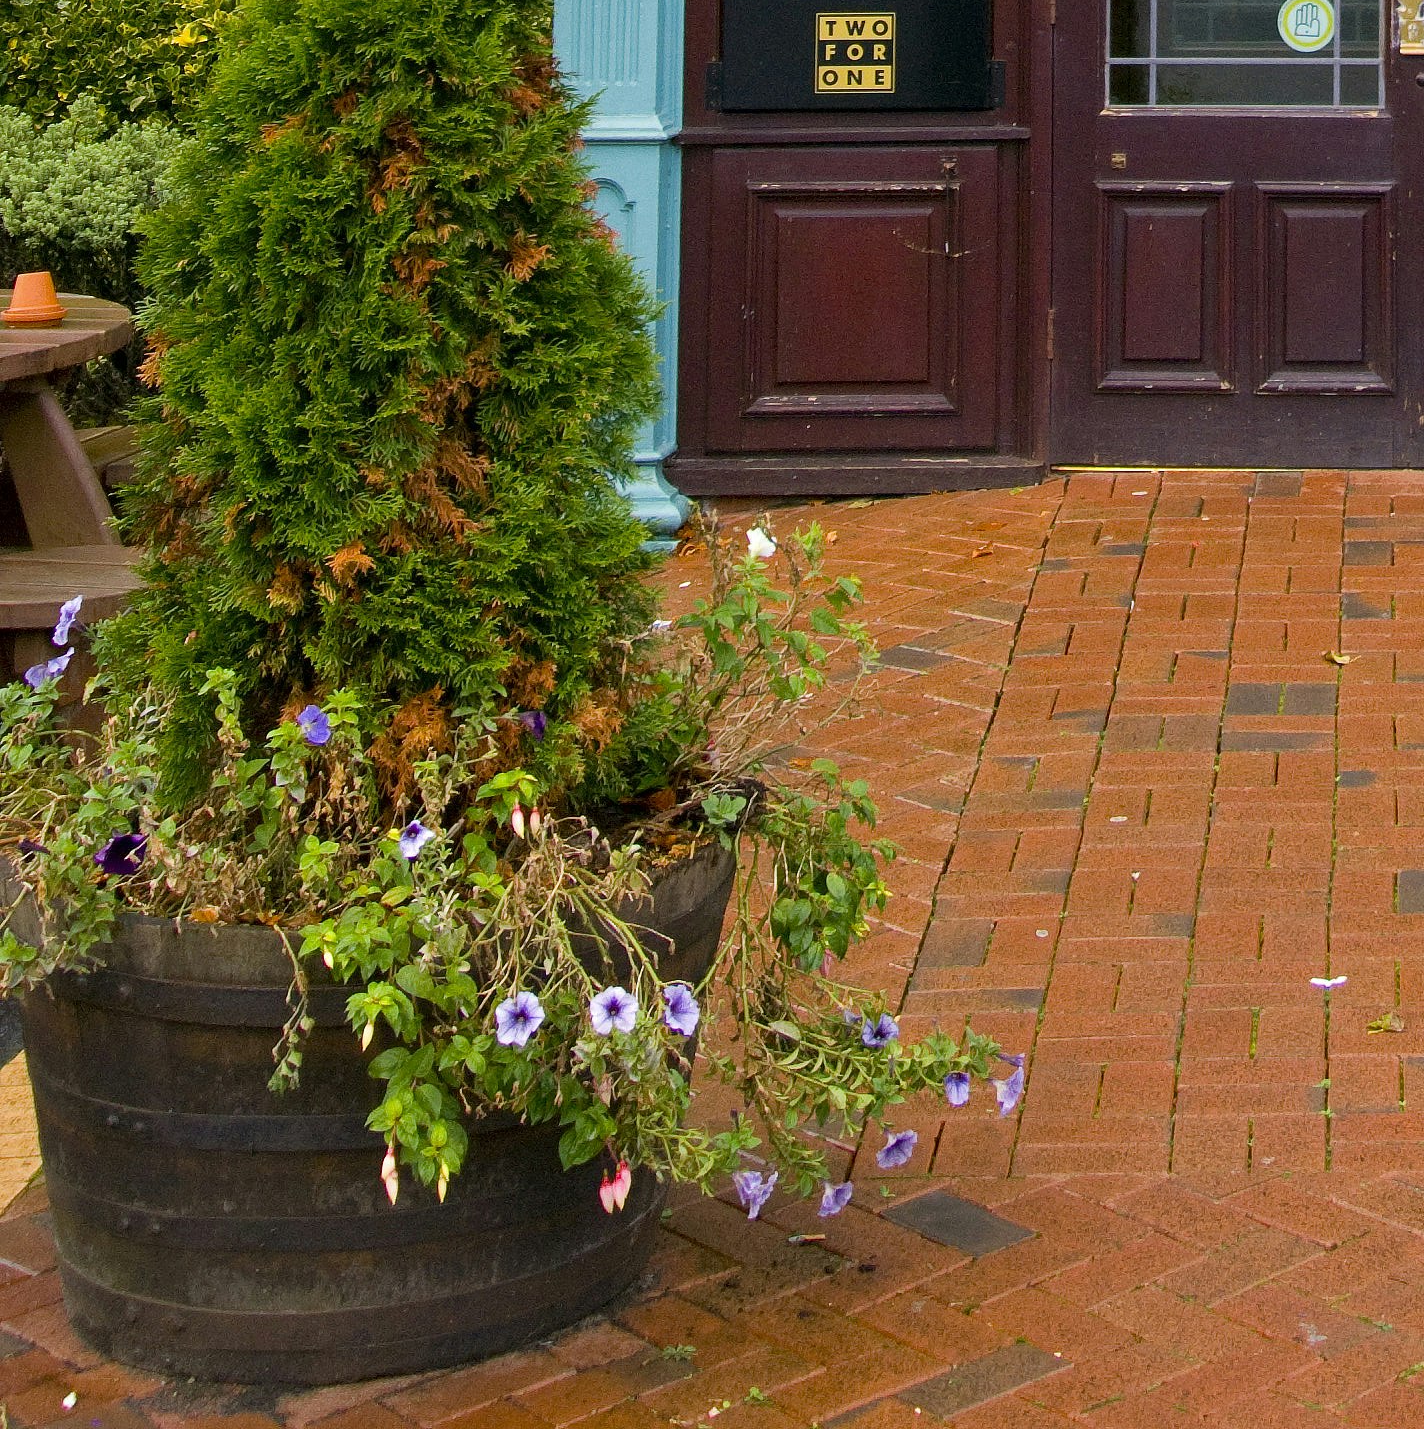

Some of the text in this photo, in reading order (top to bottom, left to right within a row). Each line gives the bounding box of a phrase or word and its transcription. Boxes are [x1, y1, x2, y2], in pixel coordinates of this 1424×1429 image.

[825, 20, 888, 36] TWO
[825, 44, 886, 61] FOR
[822, 69, 884, 86] ONE
